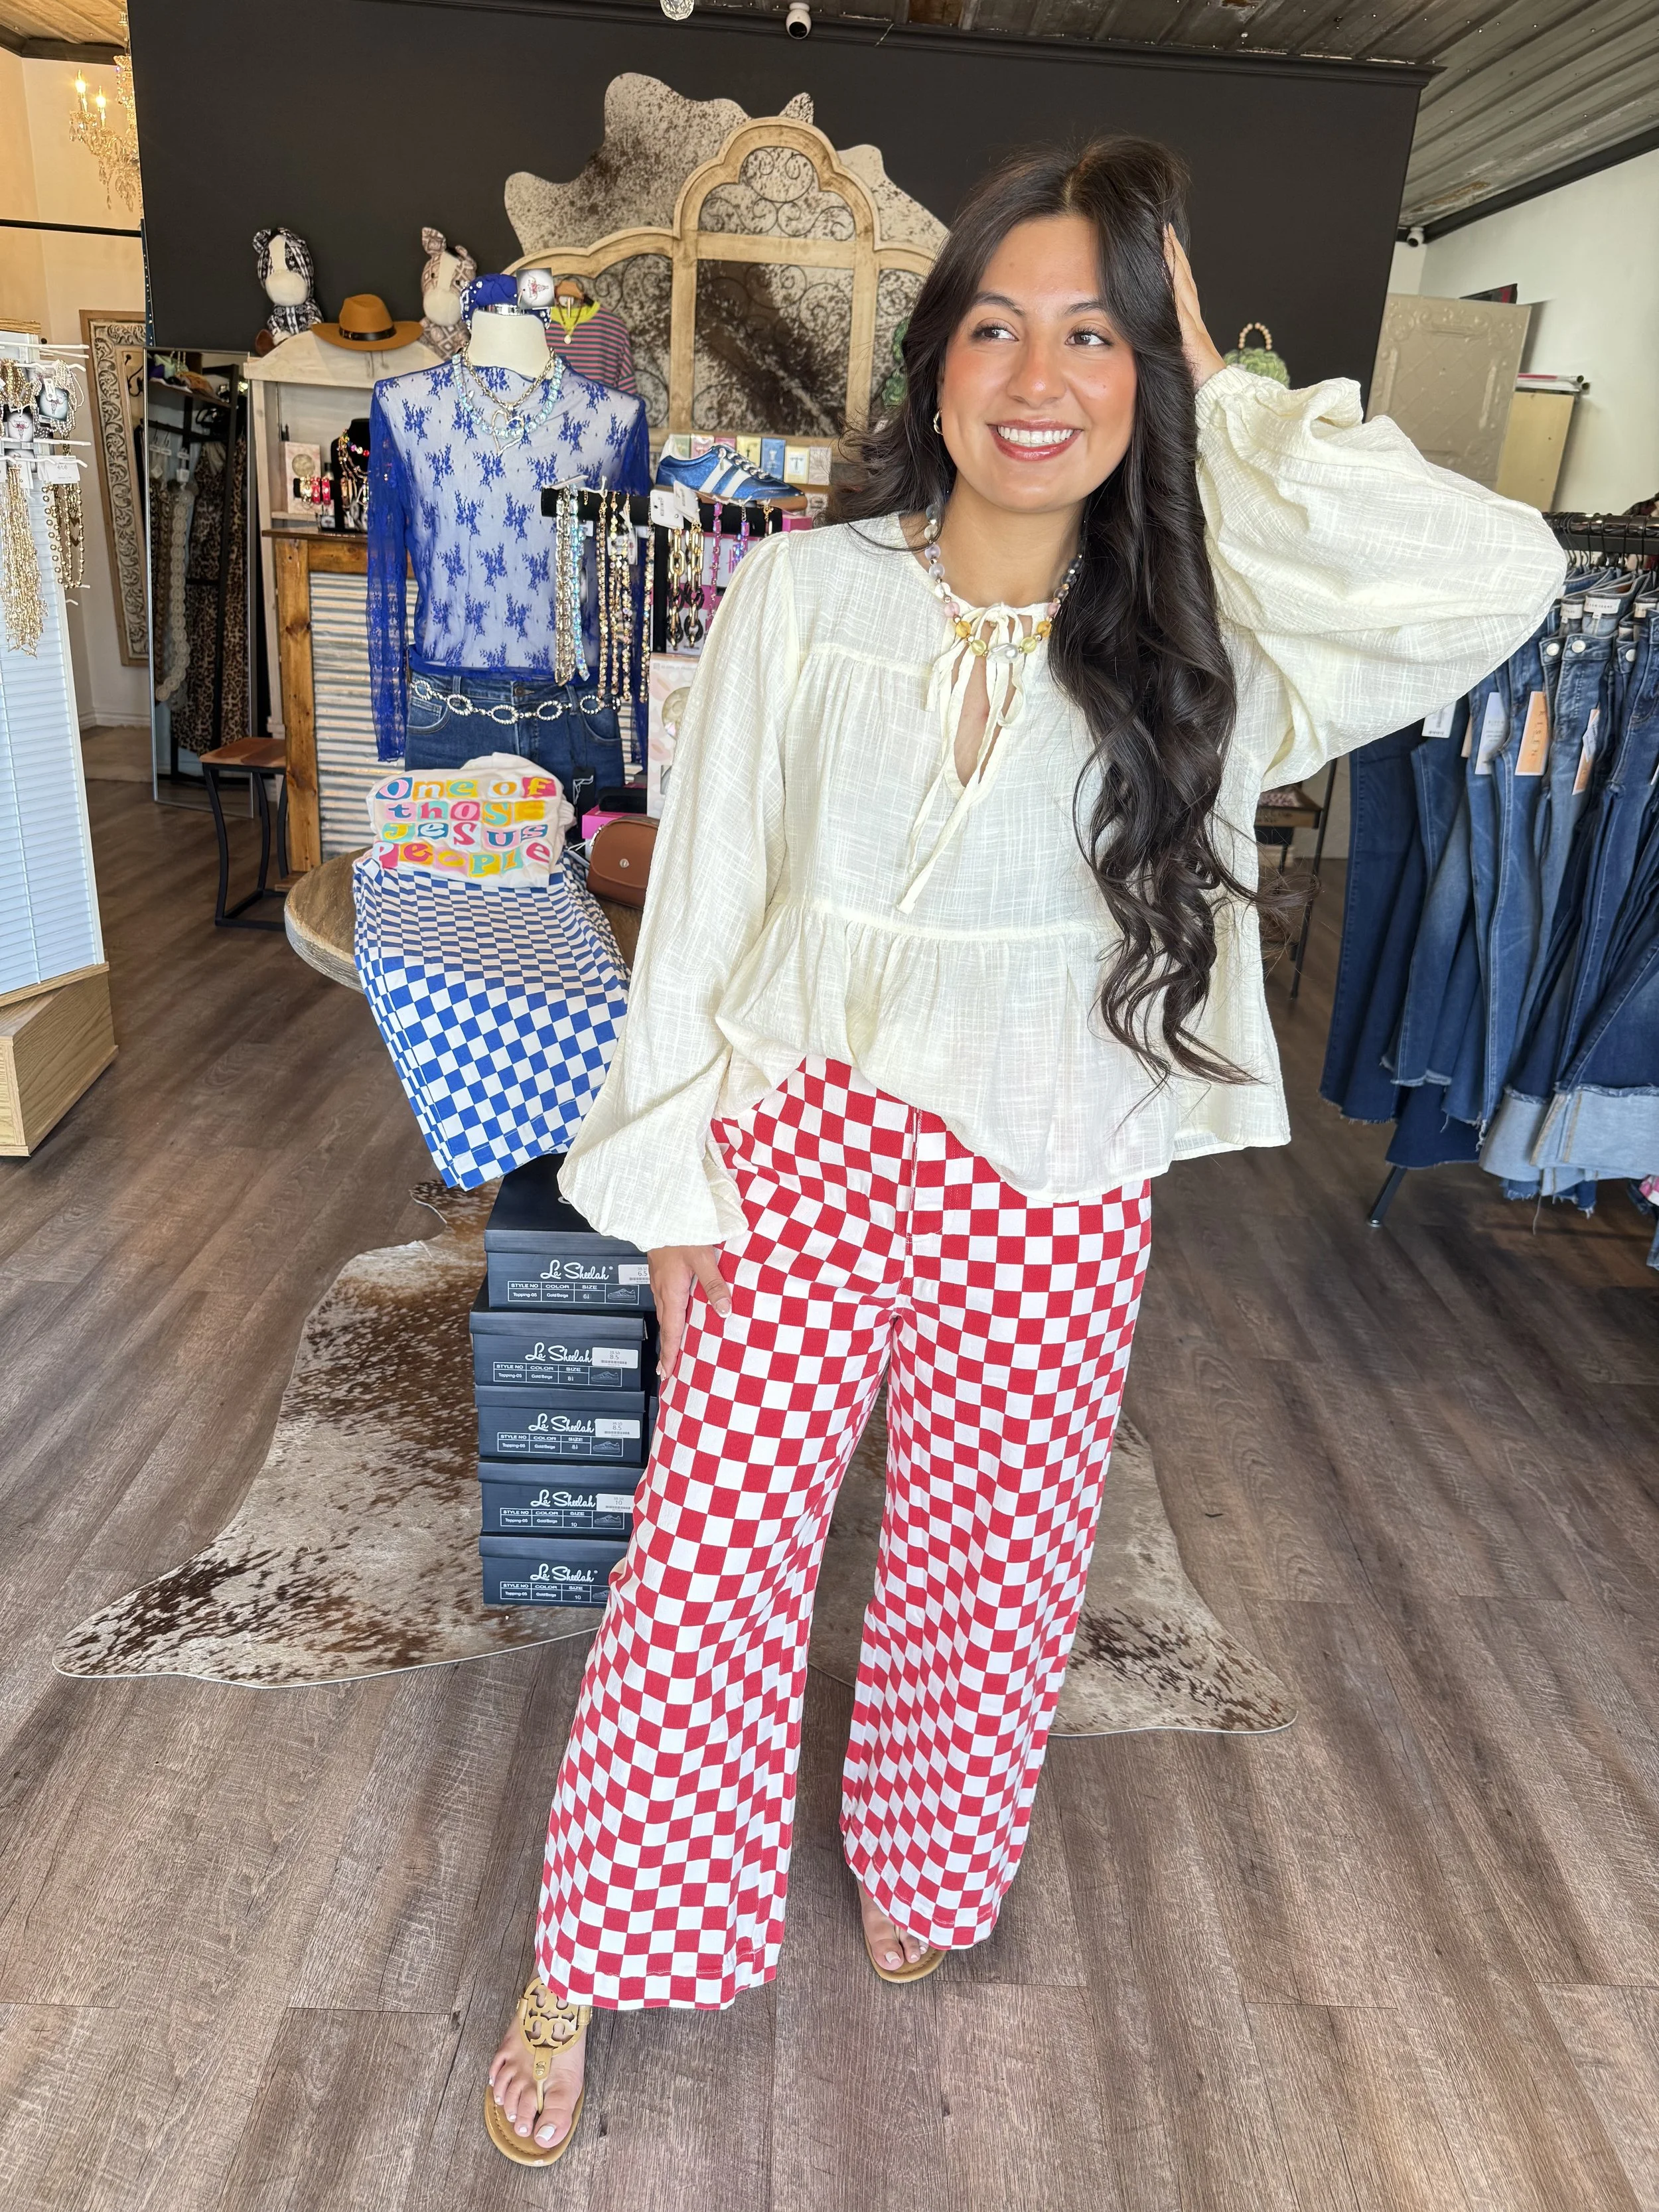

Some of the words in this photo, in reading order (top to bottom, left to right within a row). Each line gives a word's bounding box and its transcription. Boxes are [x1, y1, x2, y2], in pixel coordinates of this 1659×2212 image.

[563, 1262, 609, 1280] Sheelah
[547, 1345, 592, 1363] Sheelah
[550, 1416, 595, 1434] Sheelah
[552, 1491, 596, 1508] Sheelah
[551, 1566, 595, 1583] Sheelah
